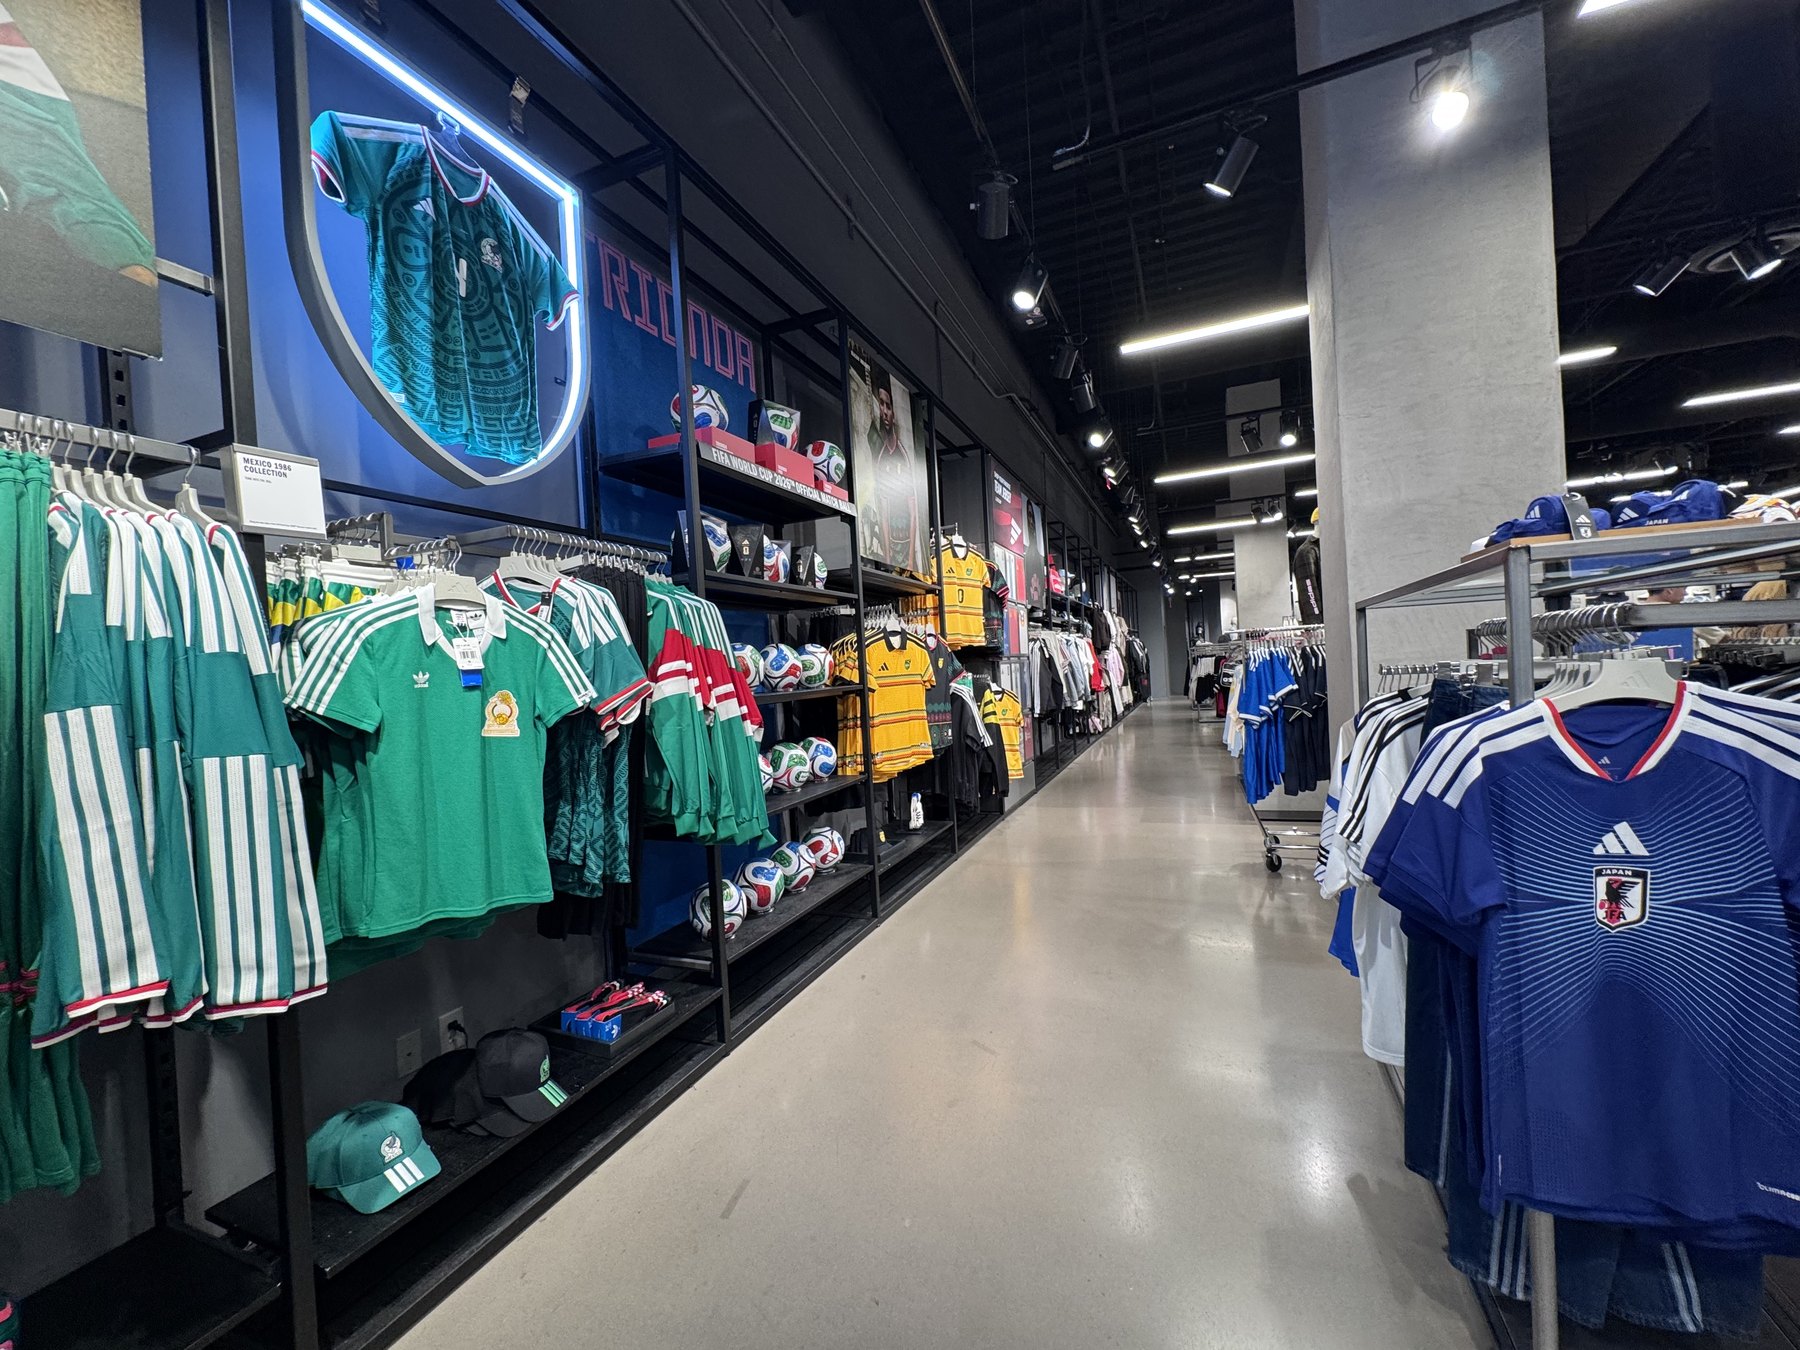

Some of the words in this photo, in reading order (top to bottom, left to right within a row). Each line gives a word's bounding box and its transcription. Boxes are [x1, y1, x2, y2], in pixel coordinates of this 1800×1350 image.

[585, 230, 756, 393] RIONDA
[243, 457, 272, 468] MEXICO
[274, 463, 292, 472] 1986
[243, 465, 288, 478] COLLECTION
[711, 447, 730, 466] FIFA
[730, 455, 757, 475] WORLD
[759, 467, 773, 482] CUP
[795, 482, 821, 501] OFFICIAL
[821, 492, 839, 508] MATCH
[1645, 518, 1669, 526] JAPAN
[1305, 579, 1320, 615] adidas
[1602, 910, 1627, 920] JFA
